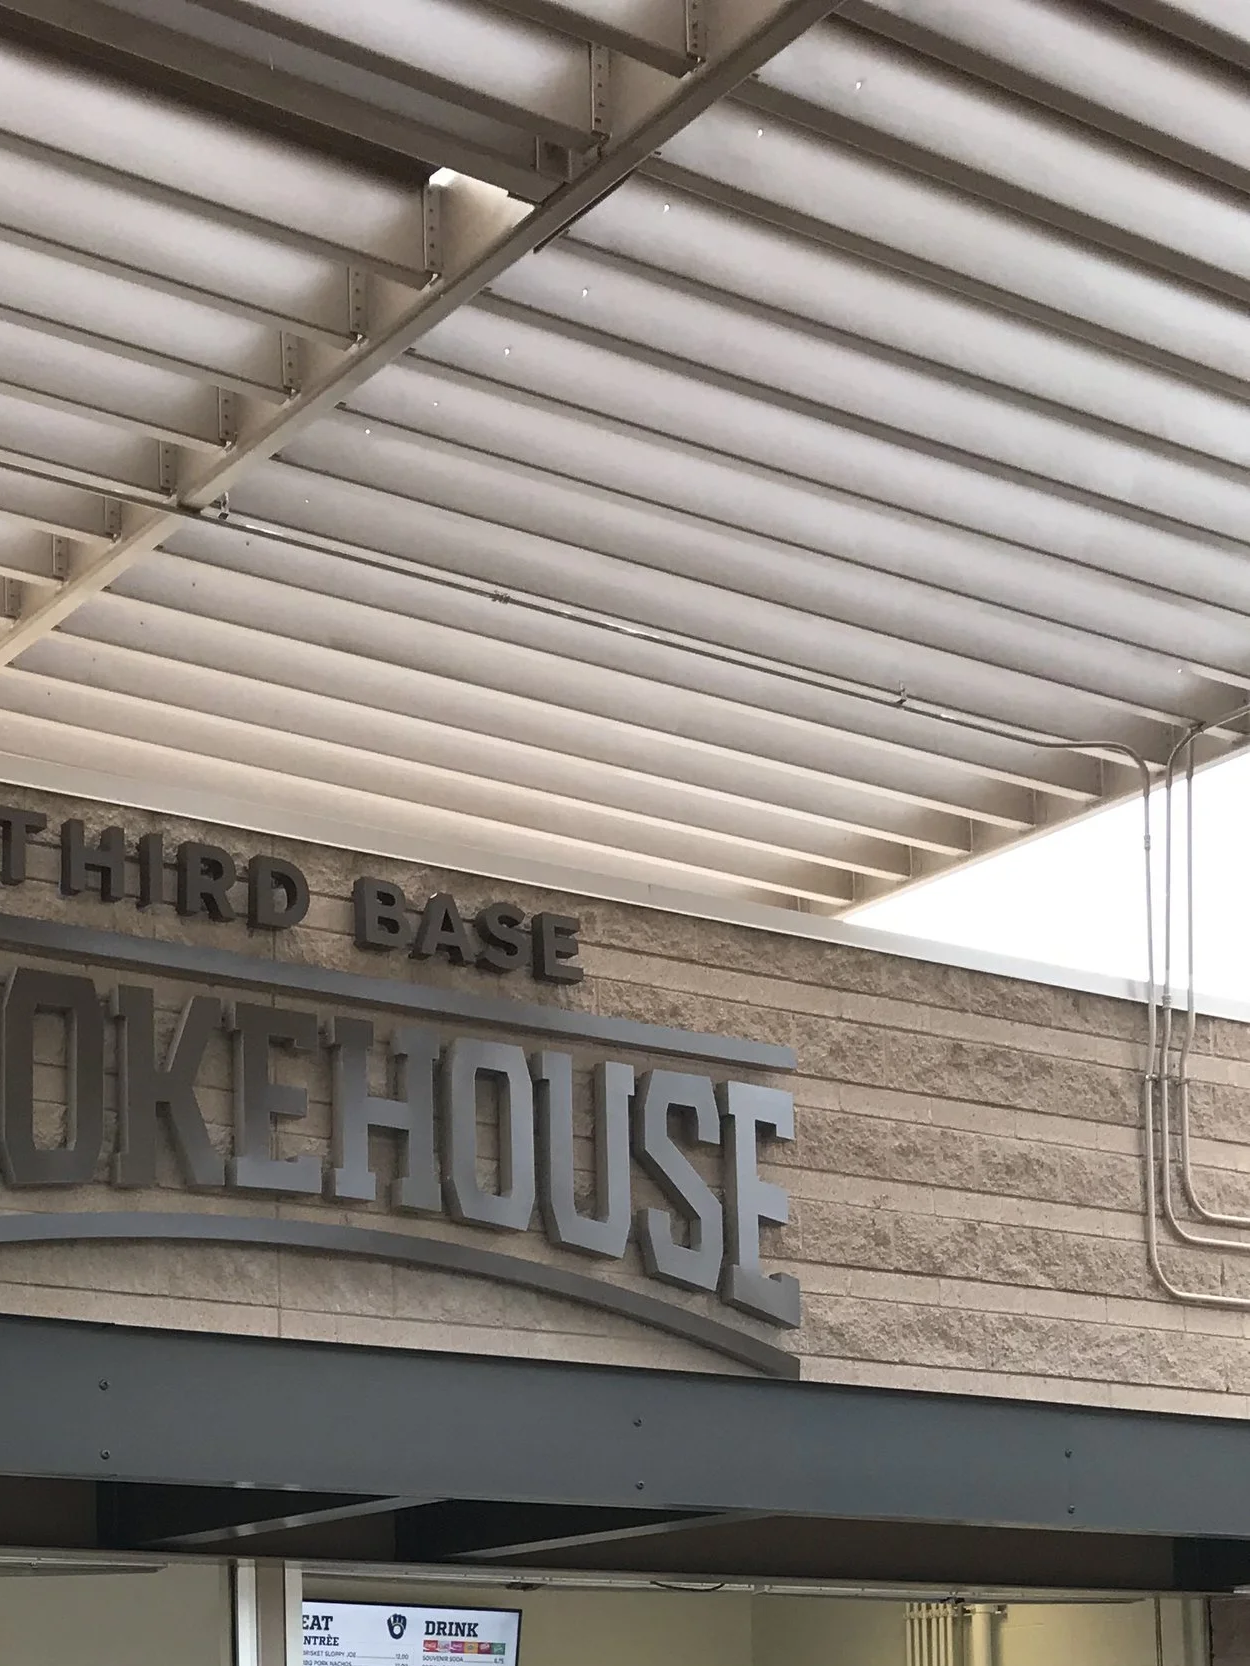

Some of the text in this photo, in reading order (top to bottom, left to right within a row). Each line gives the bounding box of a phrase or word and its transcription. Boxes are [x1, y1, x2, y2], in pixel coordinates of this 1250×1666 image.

[356, 876, 583, 985] BASE
[302, 1614, 334, 1631] EAT
[424, 1620, 478, 1637] DRINK
[303, 1634, 340, 1646] NTRÈE
